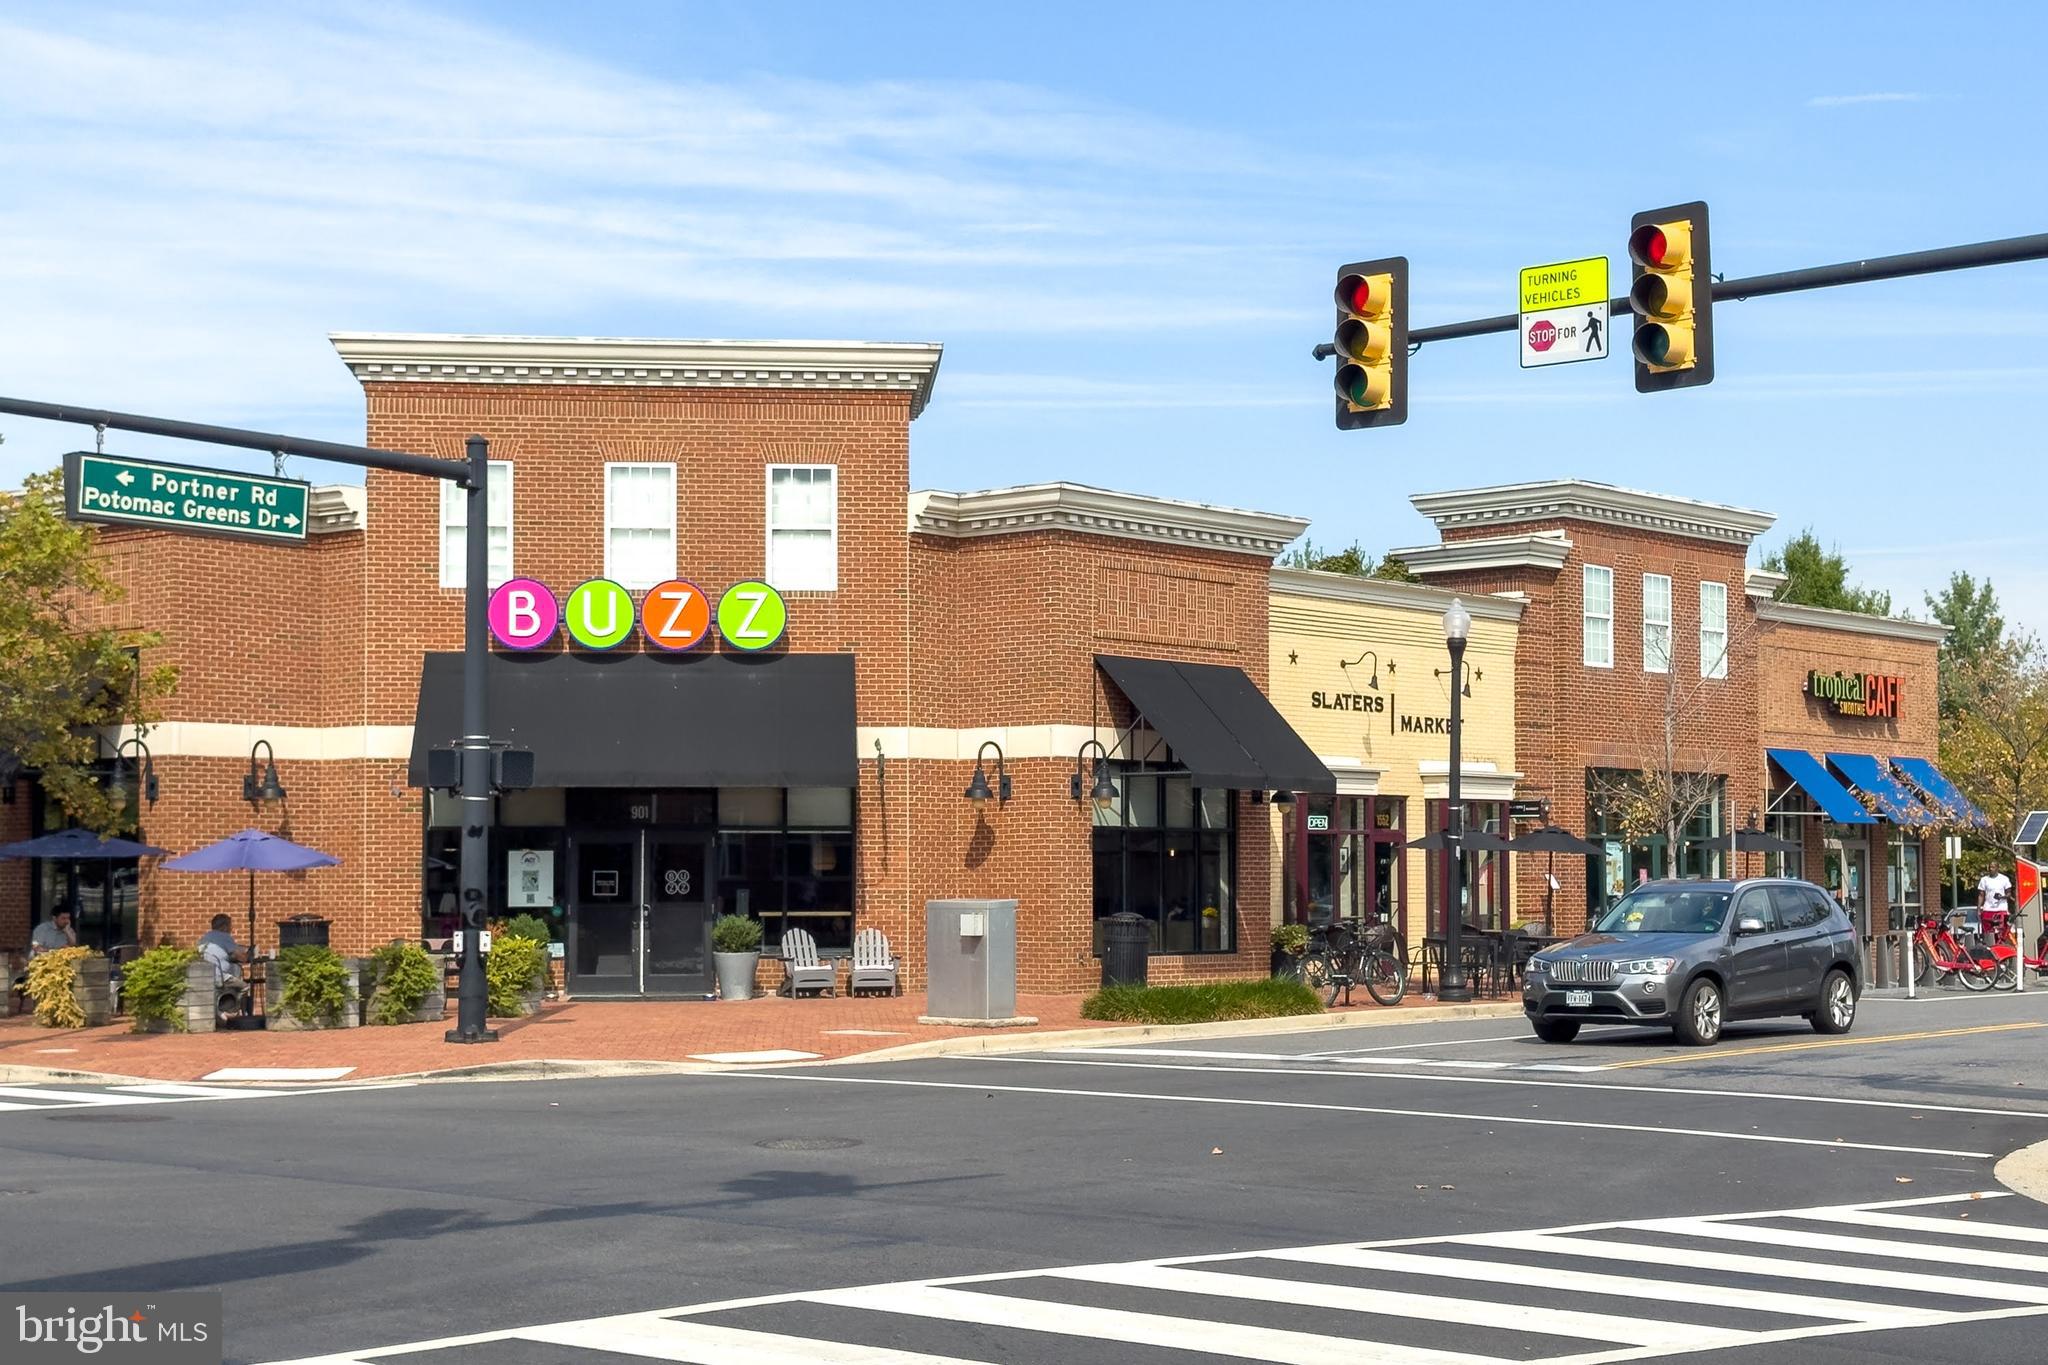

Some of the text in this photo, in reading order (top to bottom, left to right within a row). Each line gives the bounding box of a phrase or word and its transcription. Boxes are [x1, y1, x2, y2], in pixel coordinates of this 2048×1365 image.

[1528, 269, 1577, 286] TURNING
[1525, 287, 1580, 305] VEHICLES
[1529, 326, 1577, 344] STOP FOR
[152, 473, 277, 507] Portner Rd
[84, 486, 281, 529] Potomac Greens Dr
[504, 587, 772, 640] BUZZ
[1311, 691, 1384, 713] SLATERS
[1813, 670, 1905, 719] tropical CAFE
[1401, 714, 1464, 735] MARKE
[631, 805, 649, 819] 901
[1309, 818, 1328, 828] OPEN
